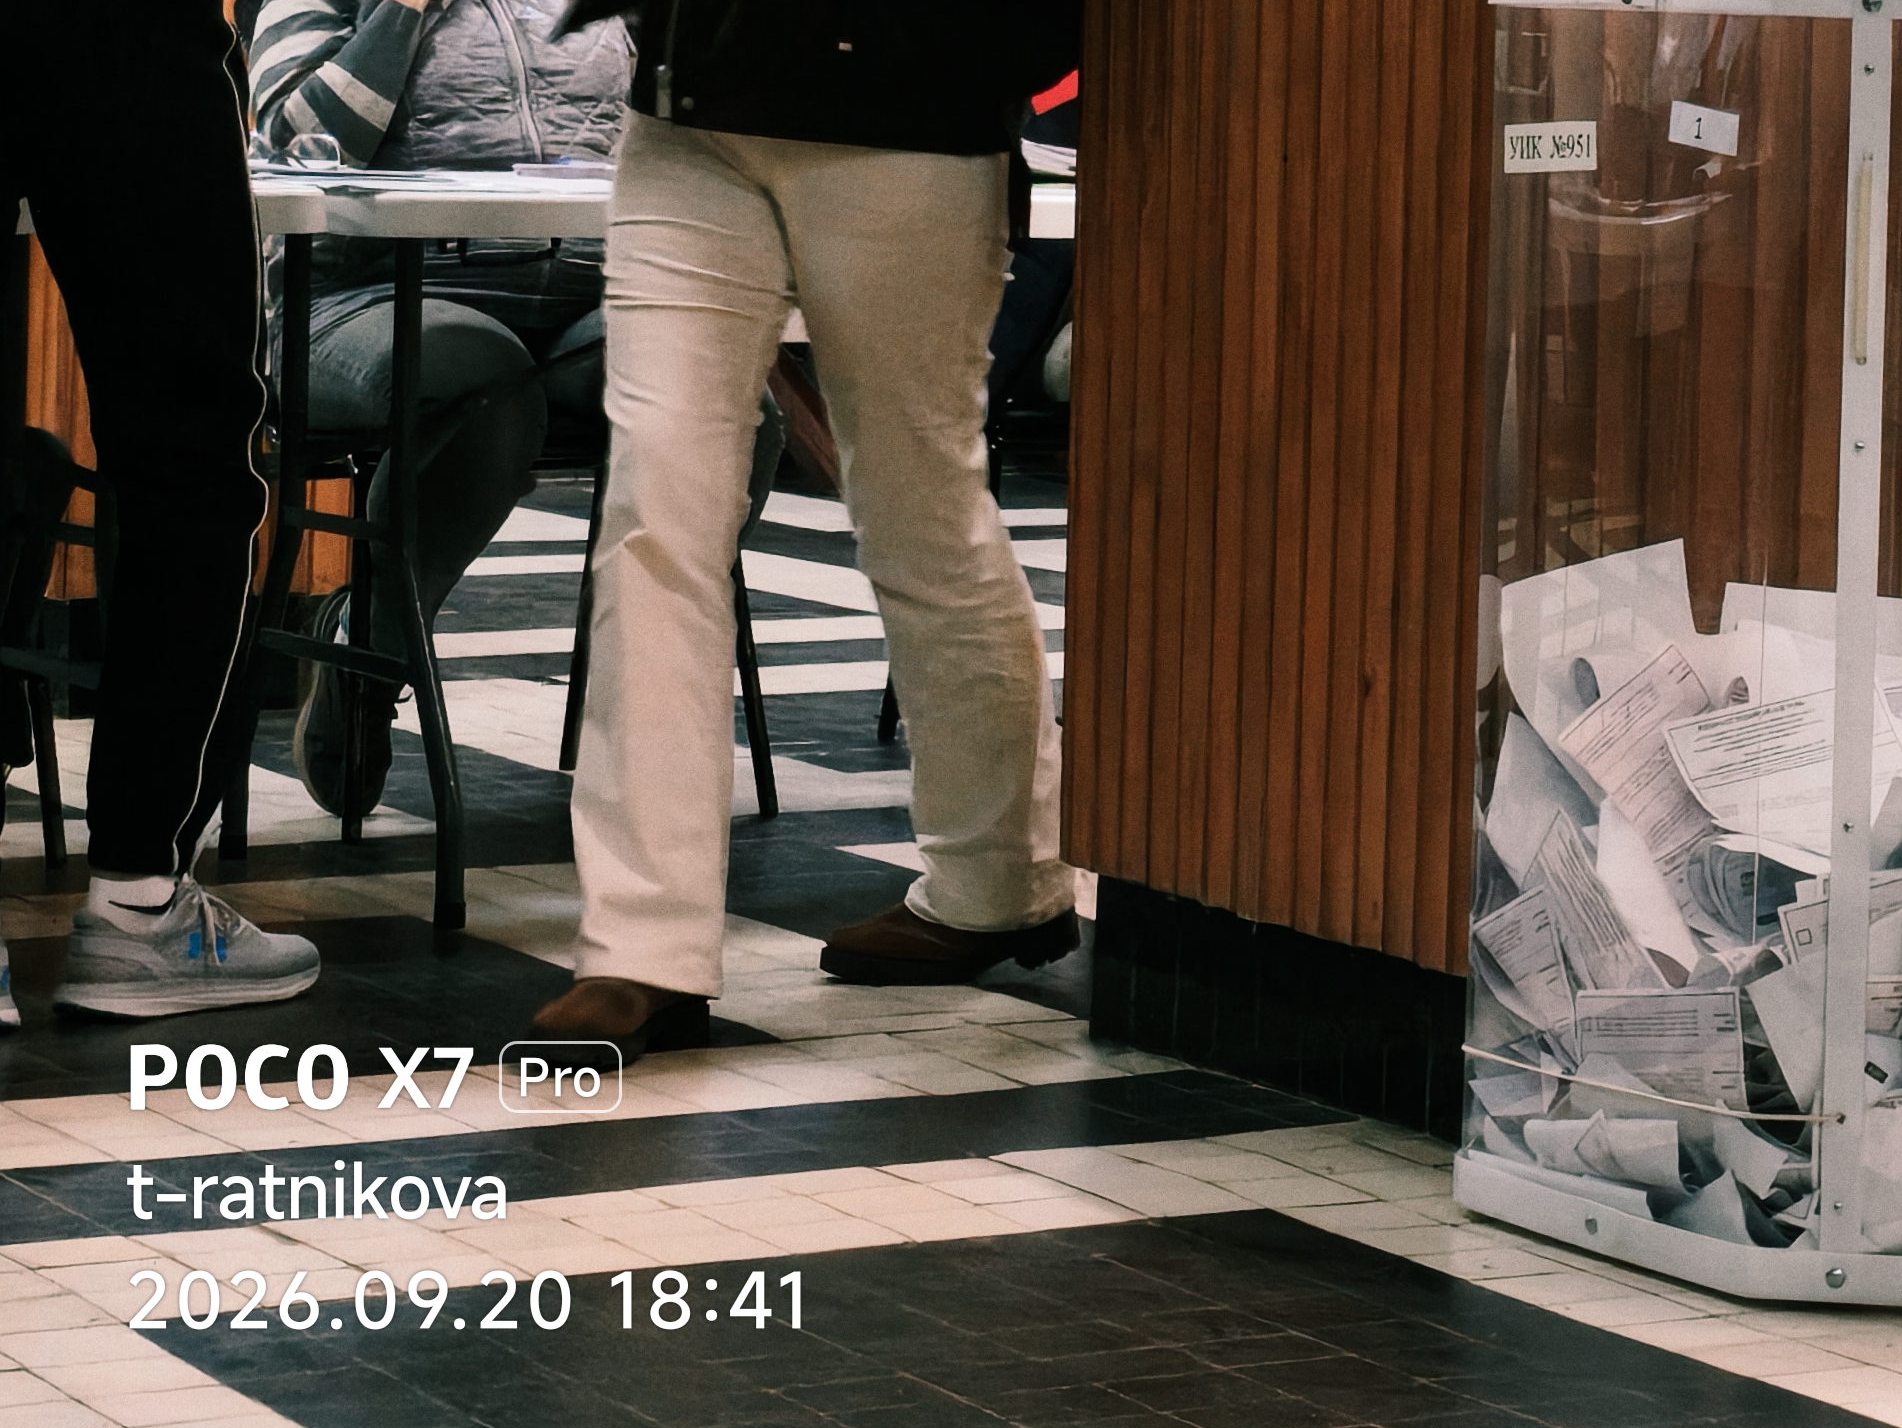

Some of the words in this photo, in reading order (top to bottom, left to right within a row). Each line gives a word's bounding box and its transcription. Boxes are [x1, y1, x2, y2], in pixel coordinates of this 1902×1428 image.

[1694, 117, 1703, 140] 1
[1509, 135, 1542, 160] УИК
[1549, 133, 1590, 160] №951
